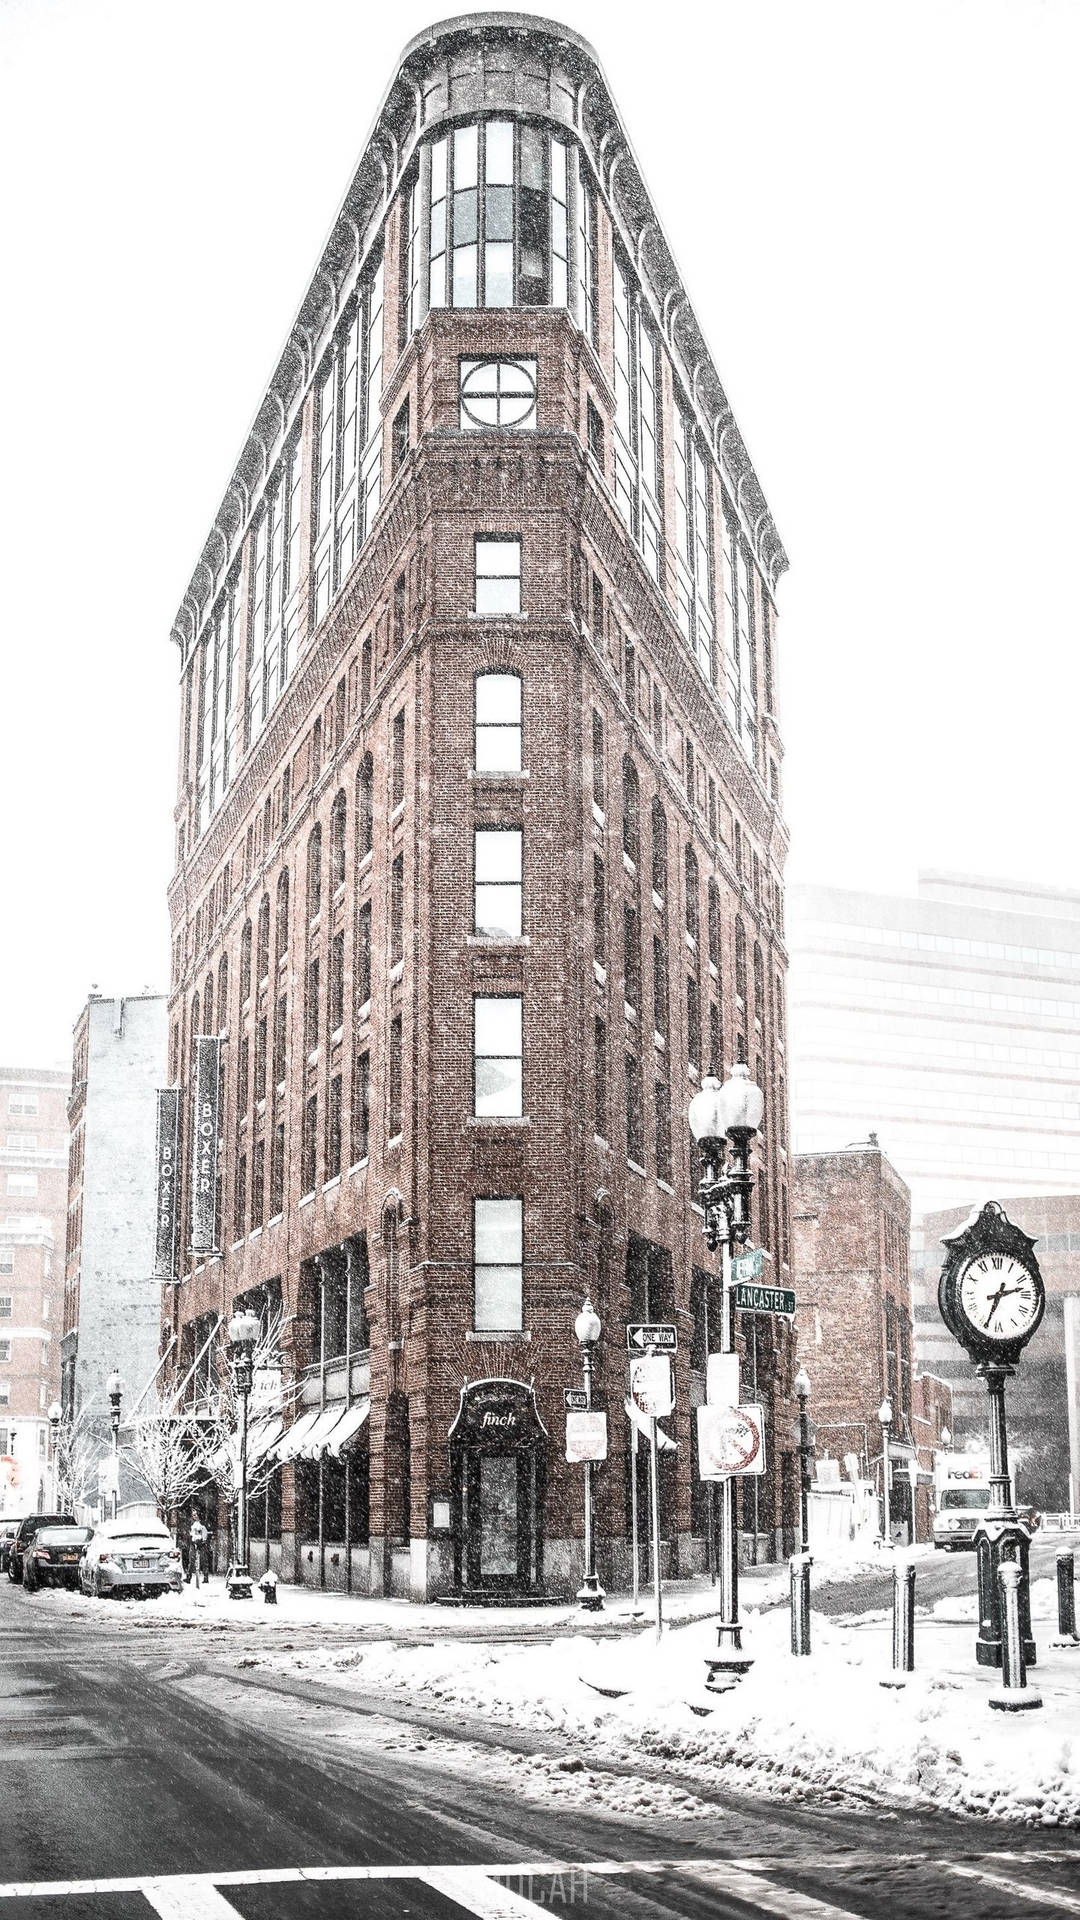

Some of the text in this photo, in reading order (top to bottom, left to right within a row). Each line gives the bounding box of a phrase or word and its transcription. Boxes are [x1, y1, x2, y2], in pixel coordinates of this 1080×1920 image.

[200, 1103, 214, 1193] BOXER
[160, 1147, 172, 1227] BOXER
[736, 1286, 785, 1311] LANCASTER
[642, 1333, 672, 1342] ONE WAY
[479, 1411, 516, 1429] finch
